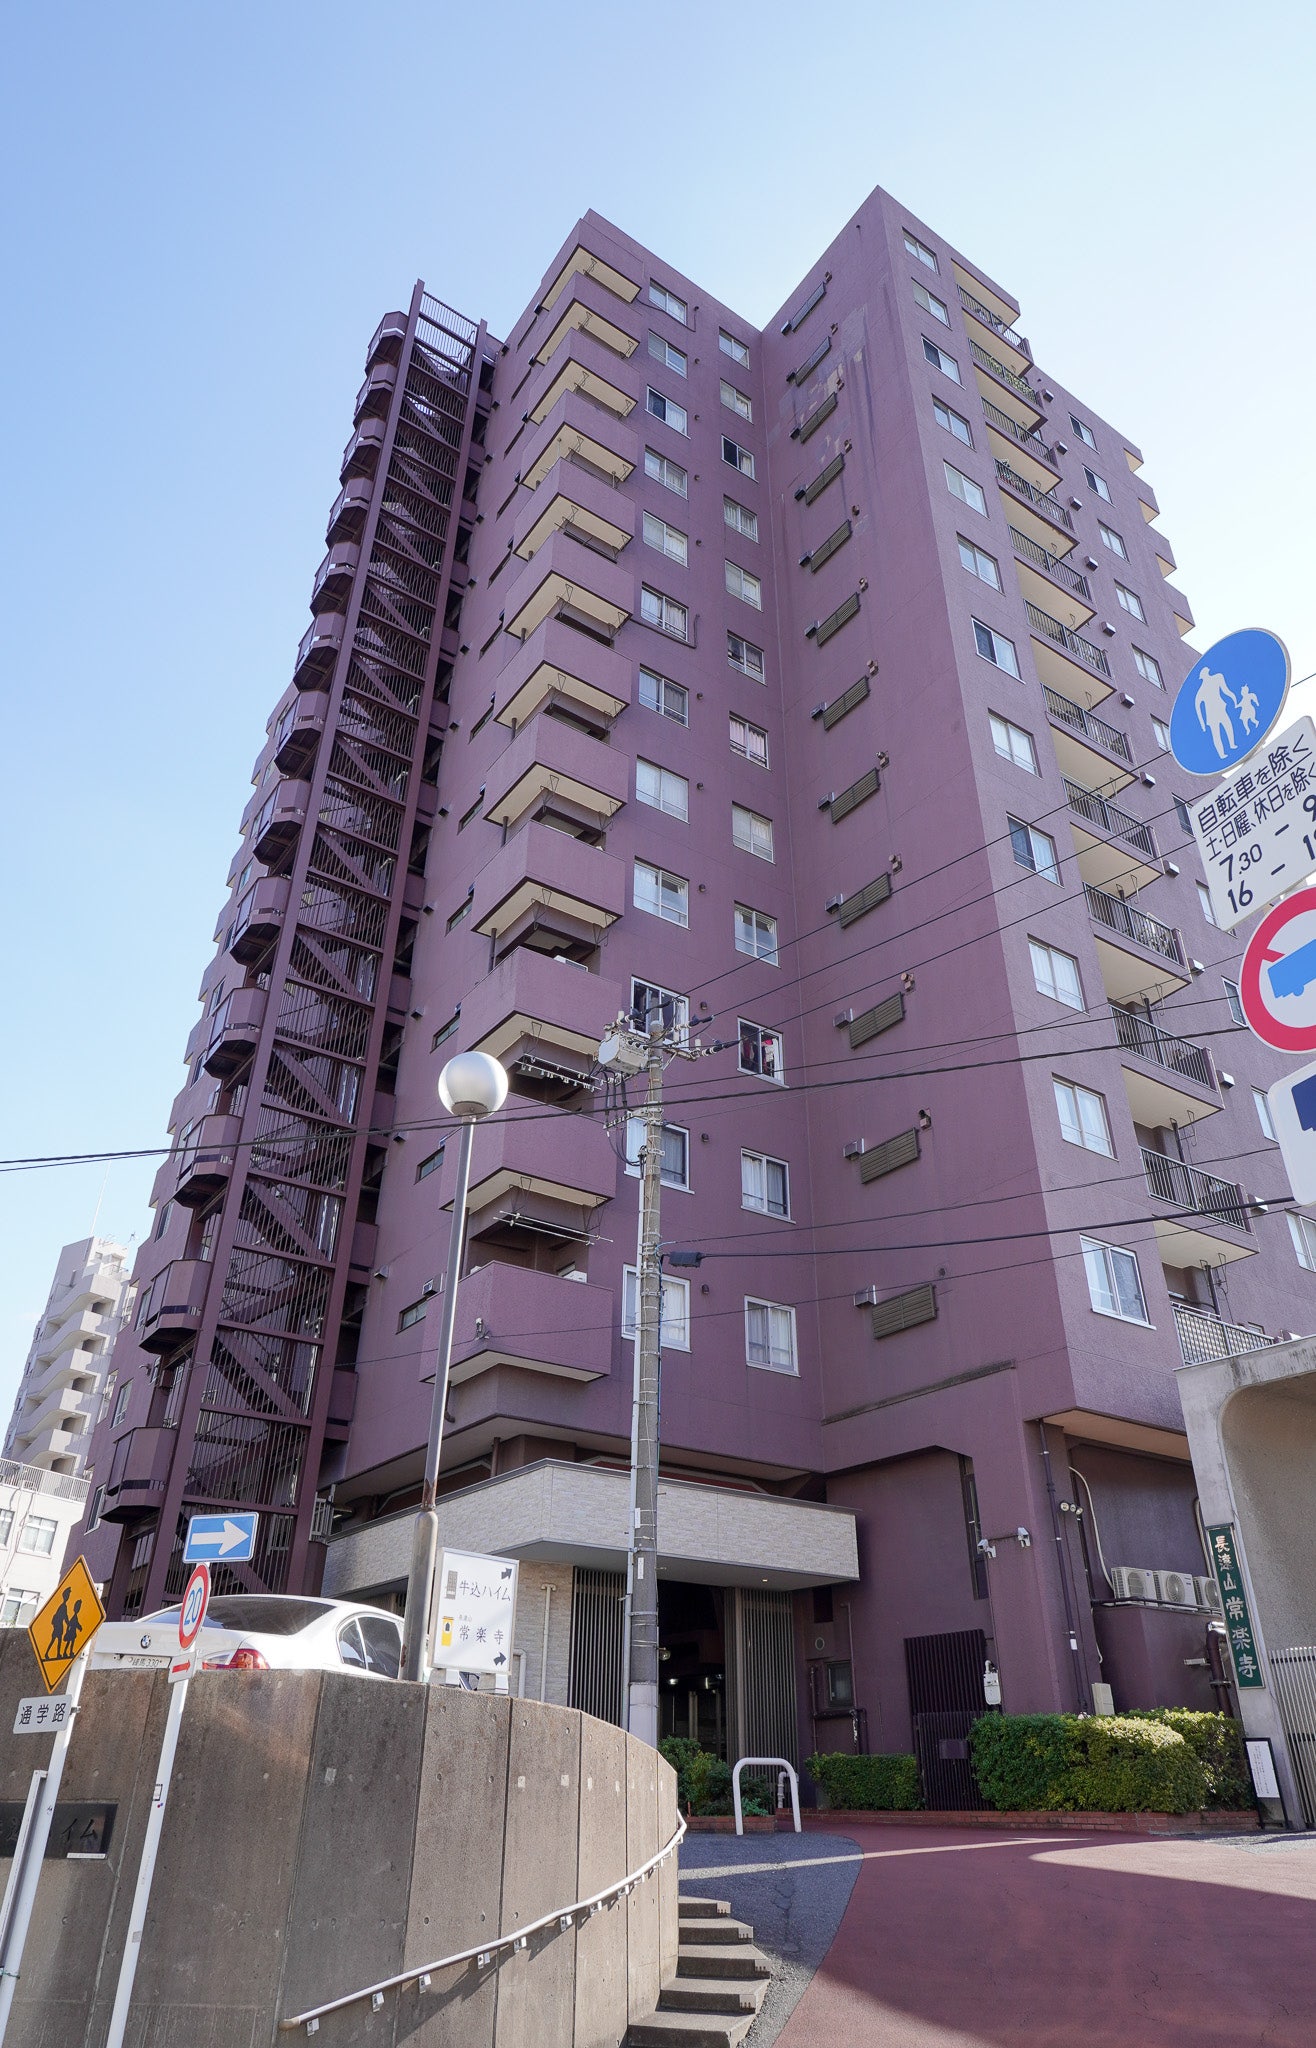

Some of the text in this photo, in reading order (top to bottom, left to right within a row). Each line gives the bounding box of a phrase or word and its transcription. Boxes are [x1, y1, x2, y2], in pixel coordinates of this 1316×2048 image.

[1198, 734, 1309, 833] 自転車を除く
[1219, 844, 1262, 882] 7.30
[1228, 880, 1253, 913] 16
[184, 1587, 203, 1626] 20
[459, 1580, 511, 1601] 牛込ハイム
[459, 1625, 504, 1645] 常楽寺
[19, 1703, 66, 1725] 通学路
